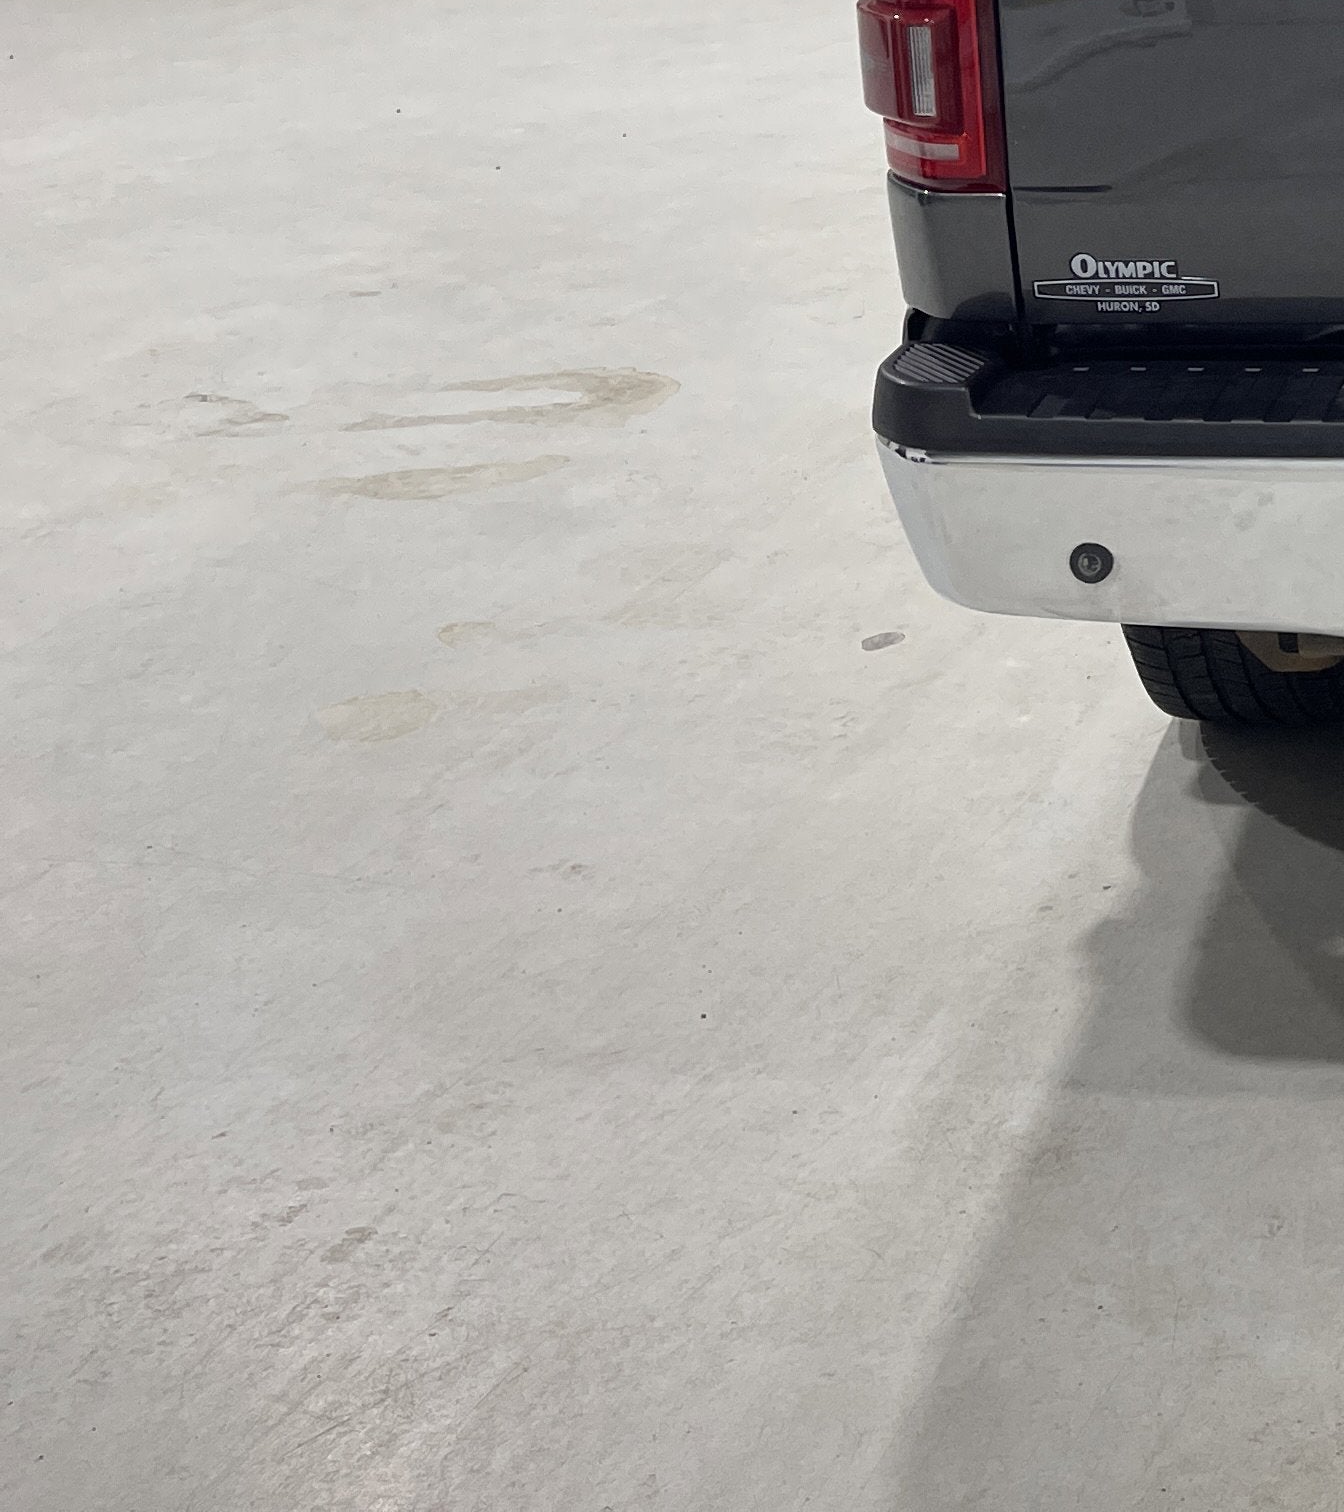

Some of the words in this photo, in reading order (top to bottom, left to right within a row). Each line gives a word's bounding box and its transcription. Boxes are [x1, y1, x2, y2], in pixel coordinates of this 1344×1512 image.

[1071, 253, 1177, 278] OLYMPIC
[1065, 285, 1100, 295] CHEVY
[1114, 285, 1148, 295] BUICK
[1161, 285, 1186, 295] GMC
[1097, 302, 1142, 312] HURON,
[1145, 302, 1160, 312] SD
